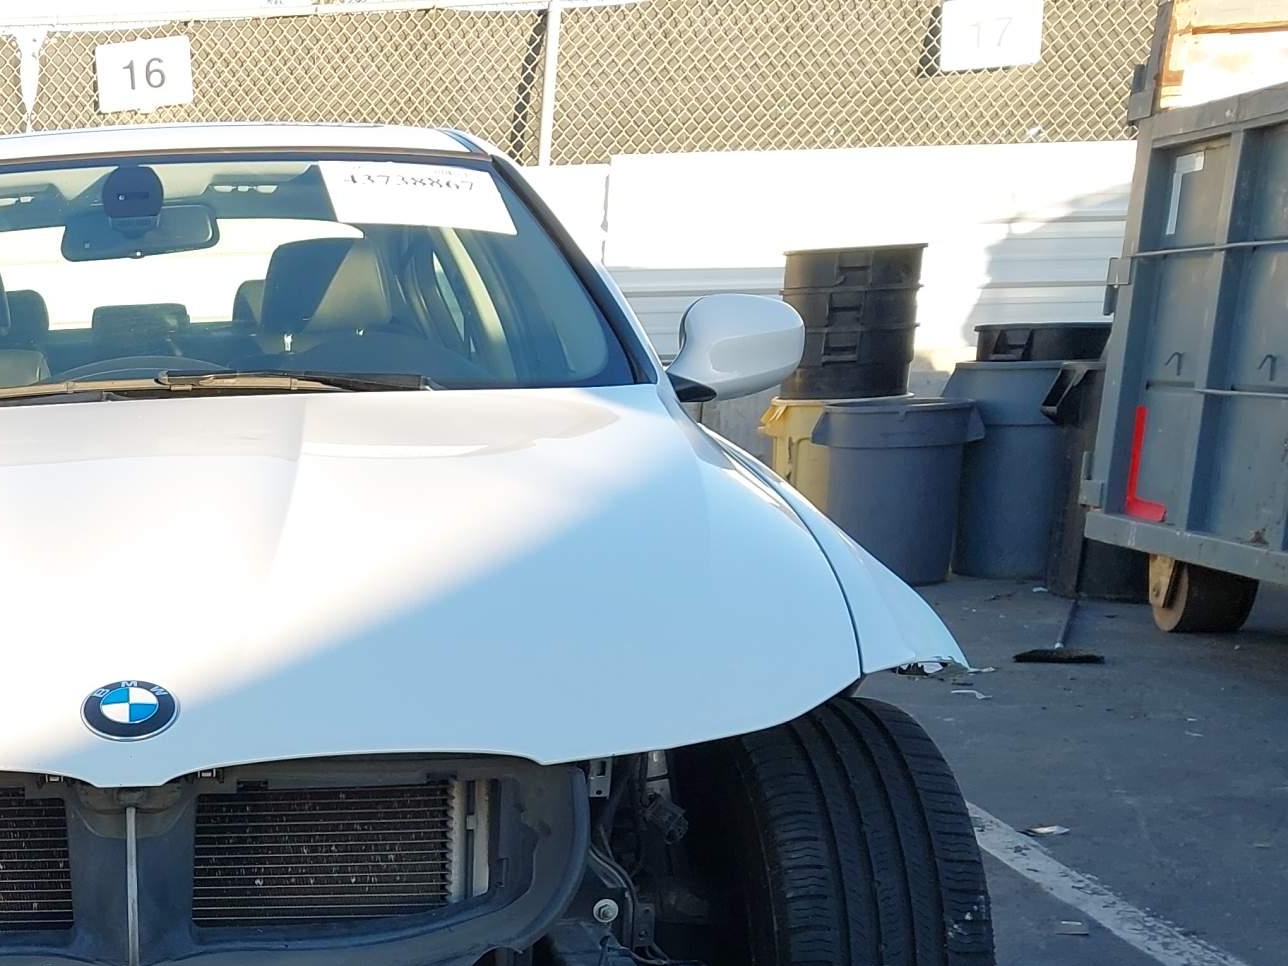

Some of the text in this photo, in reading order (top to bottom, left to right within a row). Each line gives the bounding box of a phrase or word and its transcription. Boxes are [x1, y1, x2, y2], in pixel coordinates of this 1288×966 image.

[968, 16, 1014, 49] 17
[122, 57, 166, 91] 16
[93, 680, 168, 697] BMW
